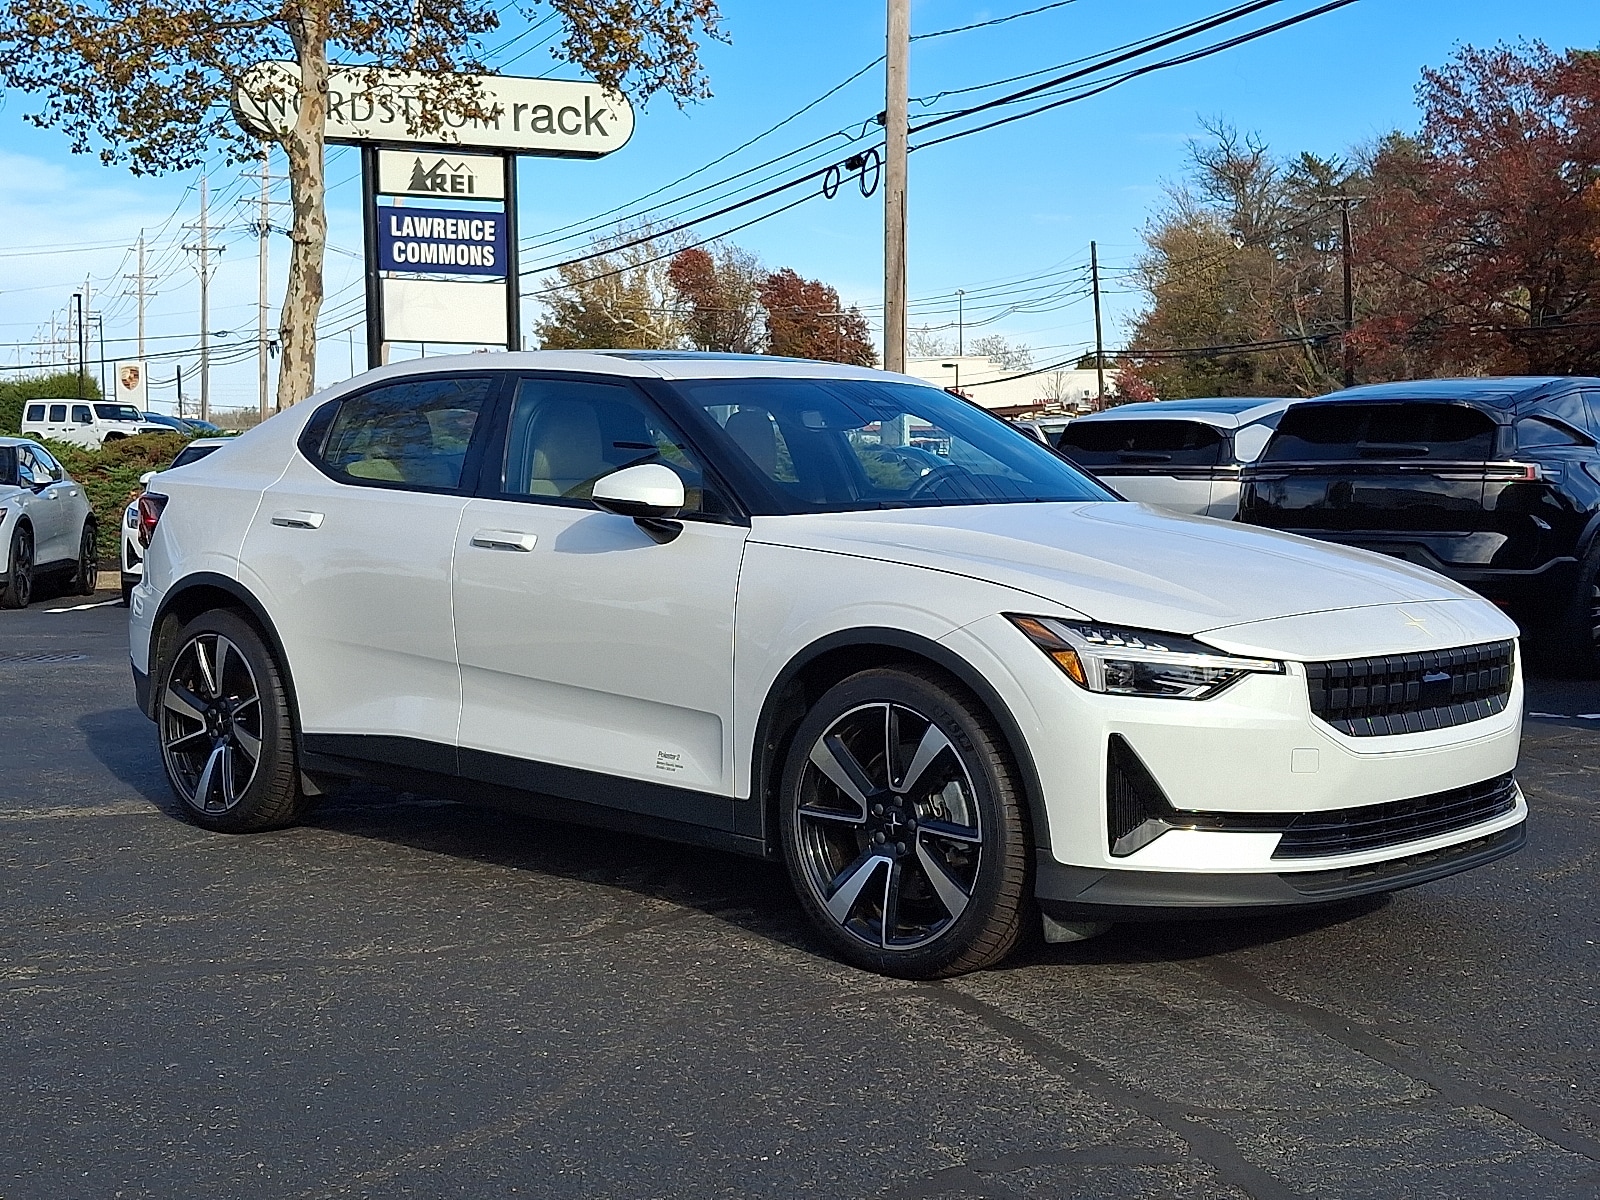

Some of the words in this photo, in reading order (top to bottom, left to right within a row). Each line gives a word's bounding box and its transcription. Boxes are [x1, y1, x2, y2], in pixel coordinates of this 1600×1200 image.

[262, 88, 500, 131] NRDSTOM
[513, 95, 610, 137] rack
[430, 173, 475, 194] REI
[391, 215, 496, 242] LAWRENCE
[393, 241, 495, 267] COMMONS
